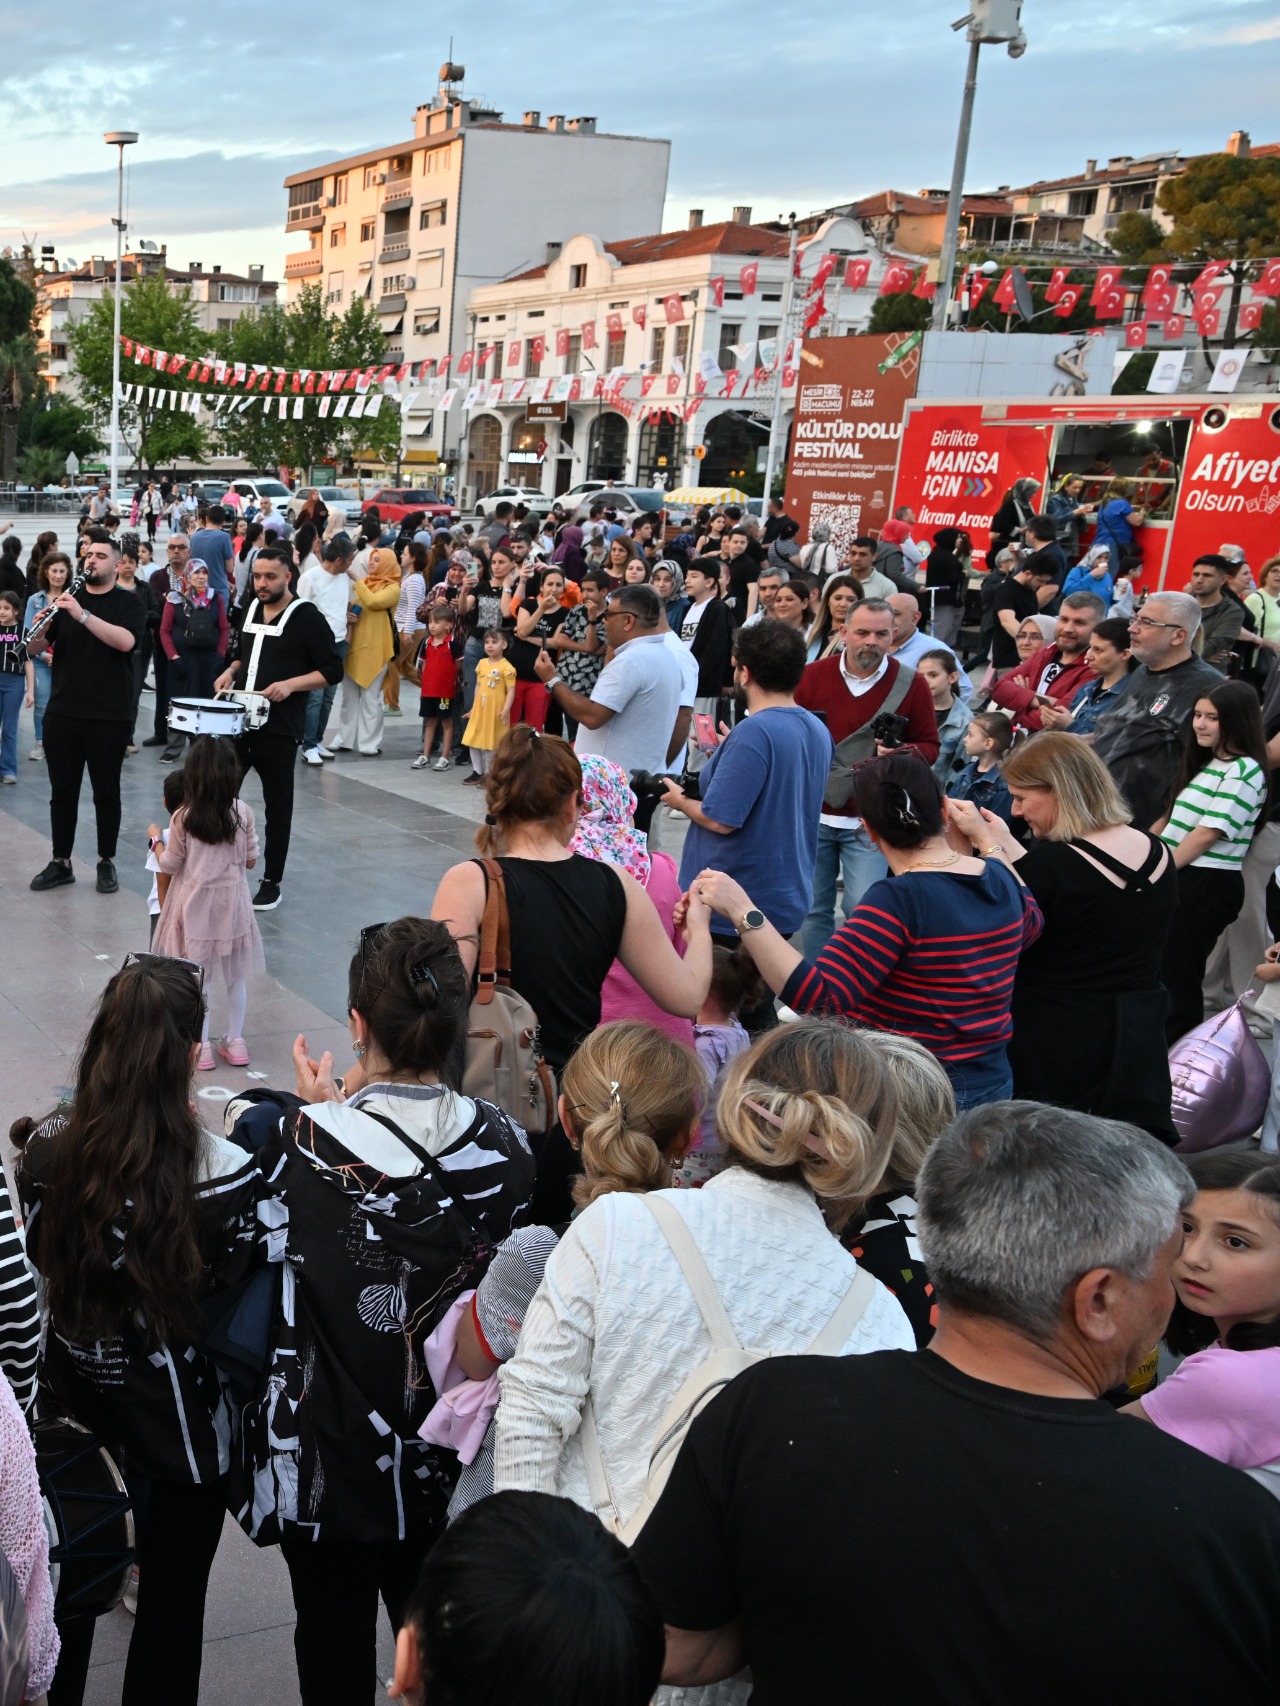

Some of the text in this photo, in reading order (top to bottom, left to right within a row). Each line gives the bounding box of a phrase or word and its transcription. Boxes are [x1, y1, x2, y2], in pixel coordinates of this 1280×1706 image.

[796, 419, 902, 439] KÜLTÜR DOLU
[931, 430, 979, 447] Birlikte
[794, 439, 864, 458] FESTİVAL
[792, 468, 803, 476] 485
[817, 469, 837, 477] festival
[850, 471, 876, 480] bekliyor!
[1190, 451, 1280, 489] Afiyet
[812, 490, 847, 501] Etkinlikler
[1184, 489, 1245, 512] Olsun
[918, 505, 993, 528] İkram Aracı
